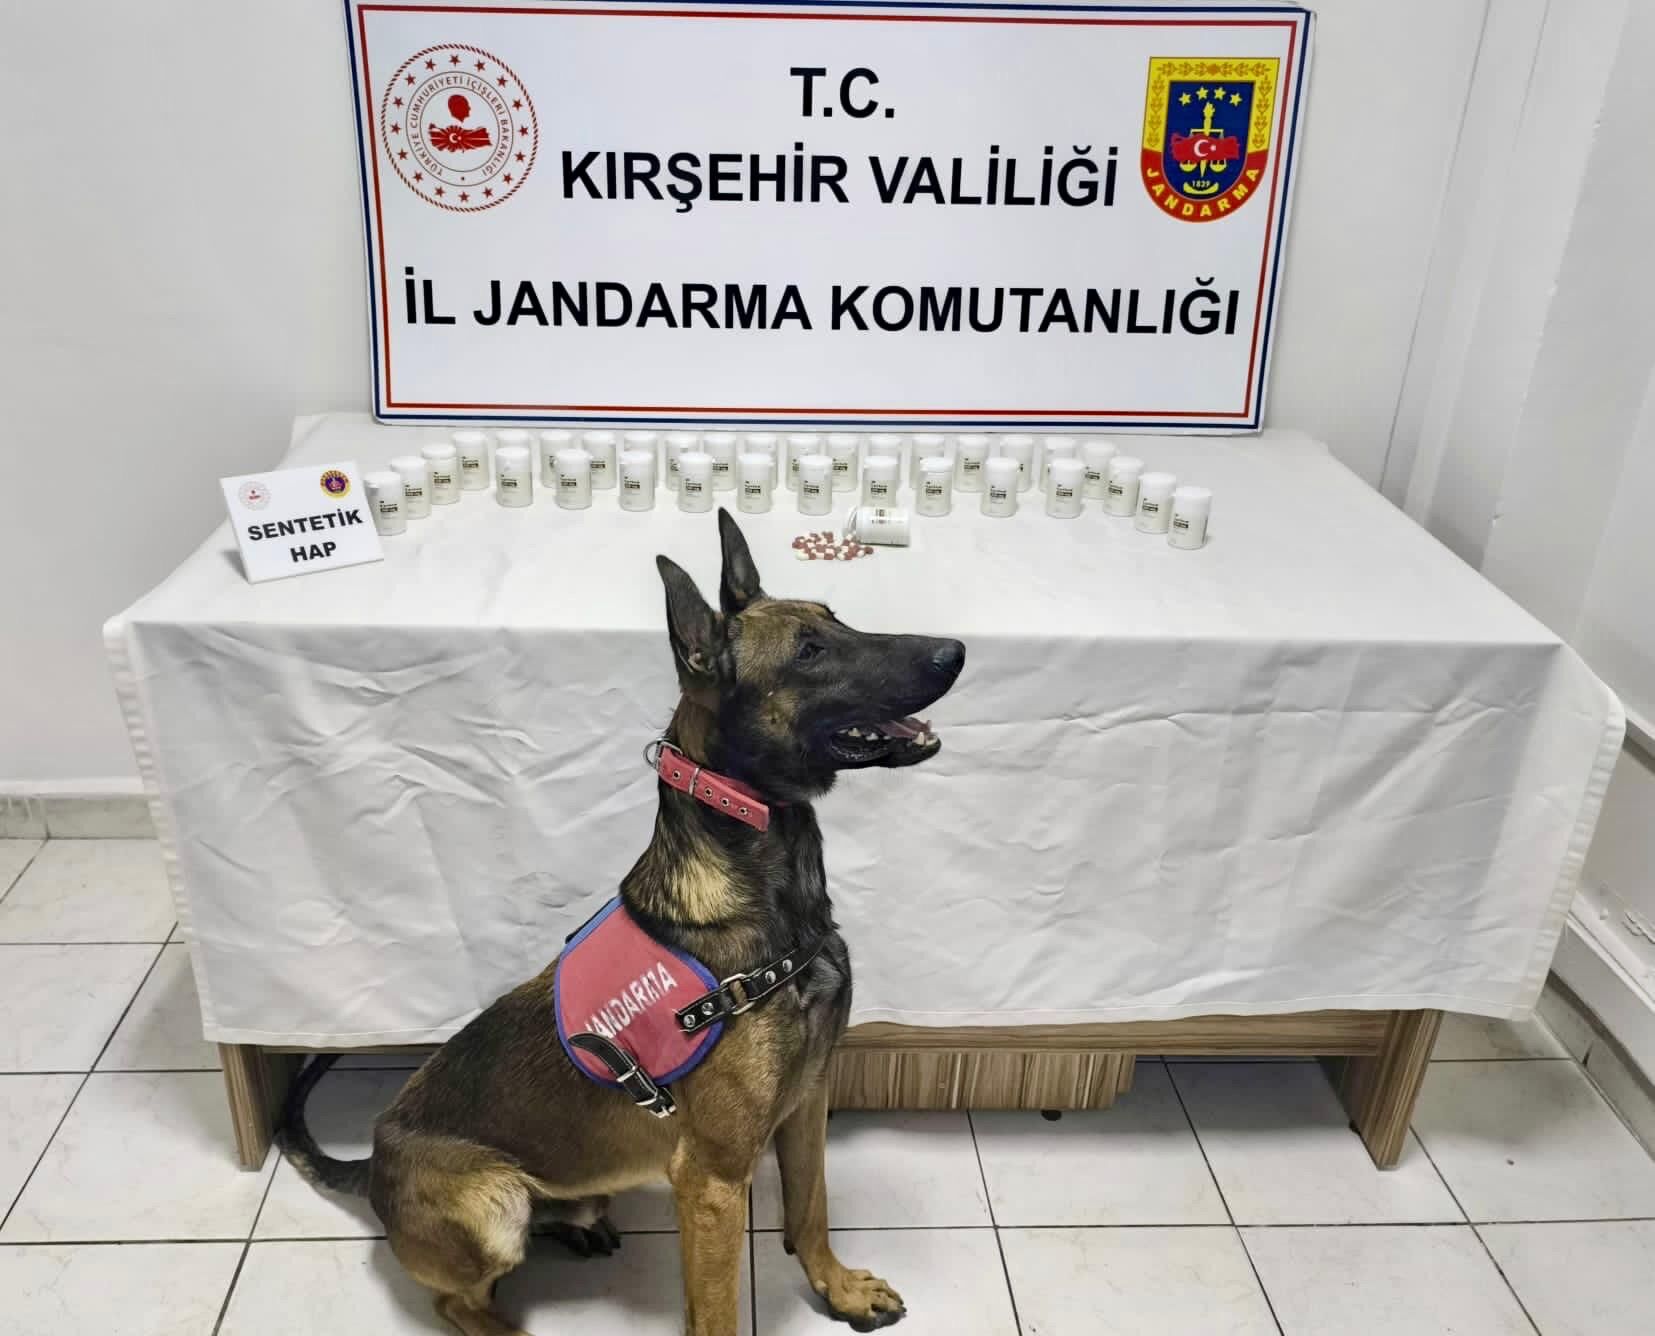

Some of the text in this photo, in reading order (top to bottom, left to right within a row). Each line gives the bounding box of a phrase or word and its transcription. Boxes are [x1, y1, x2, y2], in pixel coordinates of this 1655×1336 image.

[789, 67, 895, 119] T.C.
[410, 75, 510, 177] TÜRKİYE CUMHURİYETİ İÇİŞLERİ BAKANLIĞI
[561, 141, 1118, 214] KIRŞEHİR VALİLİĞİ
[1146, 168, 1259, 217] JANDARMA
[404, 266, 1240, 336] İL JANDARMA KOMUTANLIĞI
[248, 508, 363, 541] SENTETİK
[290, 541, 337, 563] HAP
